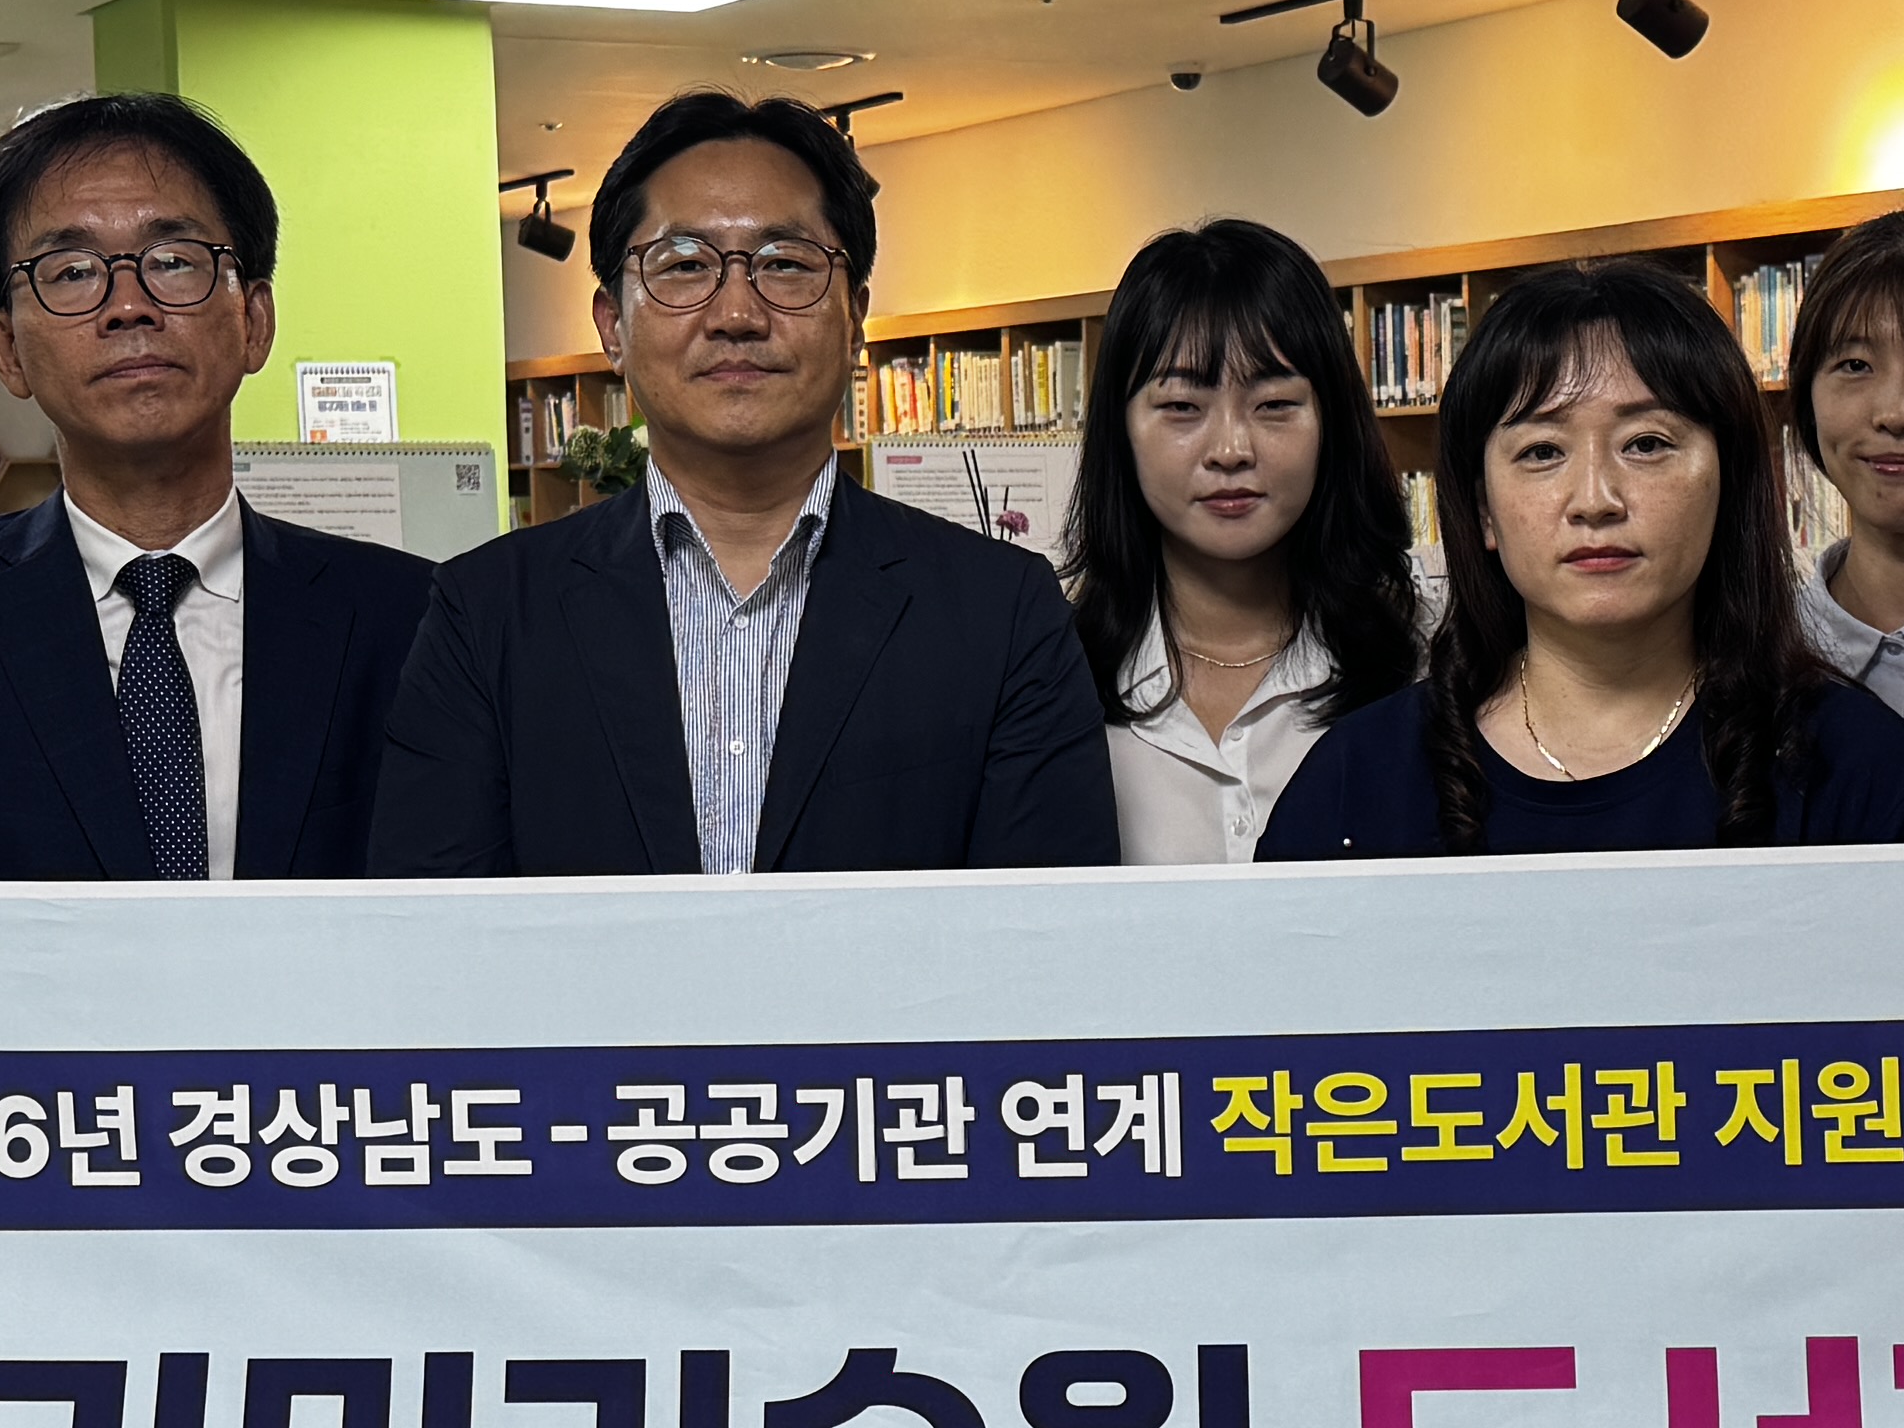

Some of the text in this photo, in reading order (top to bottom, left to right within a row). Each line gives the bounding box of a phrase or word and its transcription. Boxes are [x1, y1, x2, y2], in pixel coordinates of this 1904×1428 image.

[169, 1081, 534, 1190] 경상남도
[607, 1075, 974, 1185] 공공기관
[1001, 1071, 1182, 1178] 연계
[1209, 1061, 1687, 1176] 작은도서관
